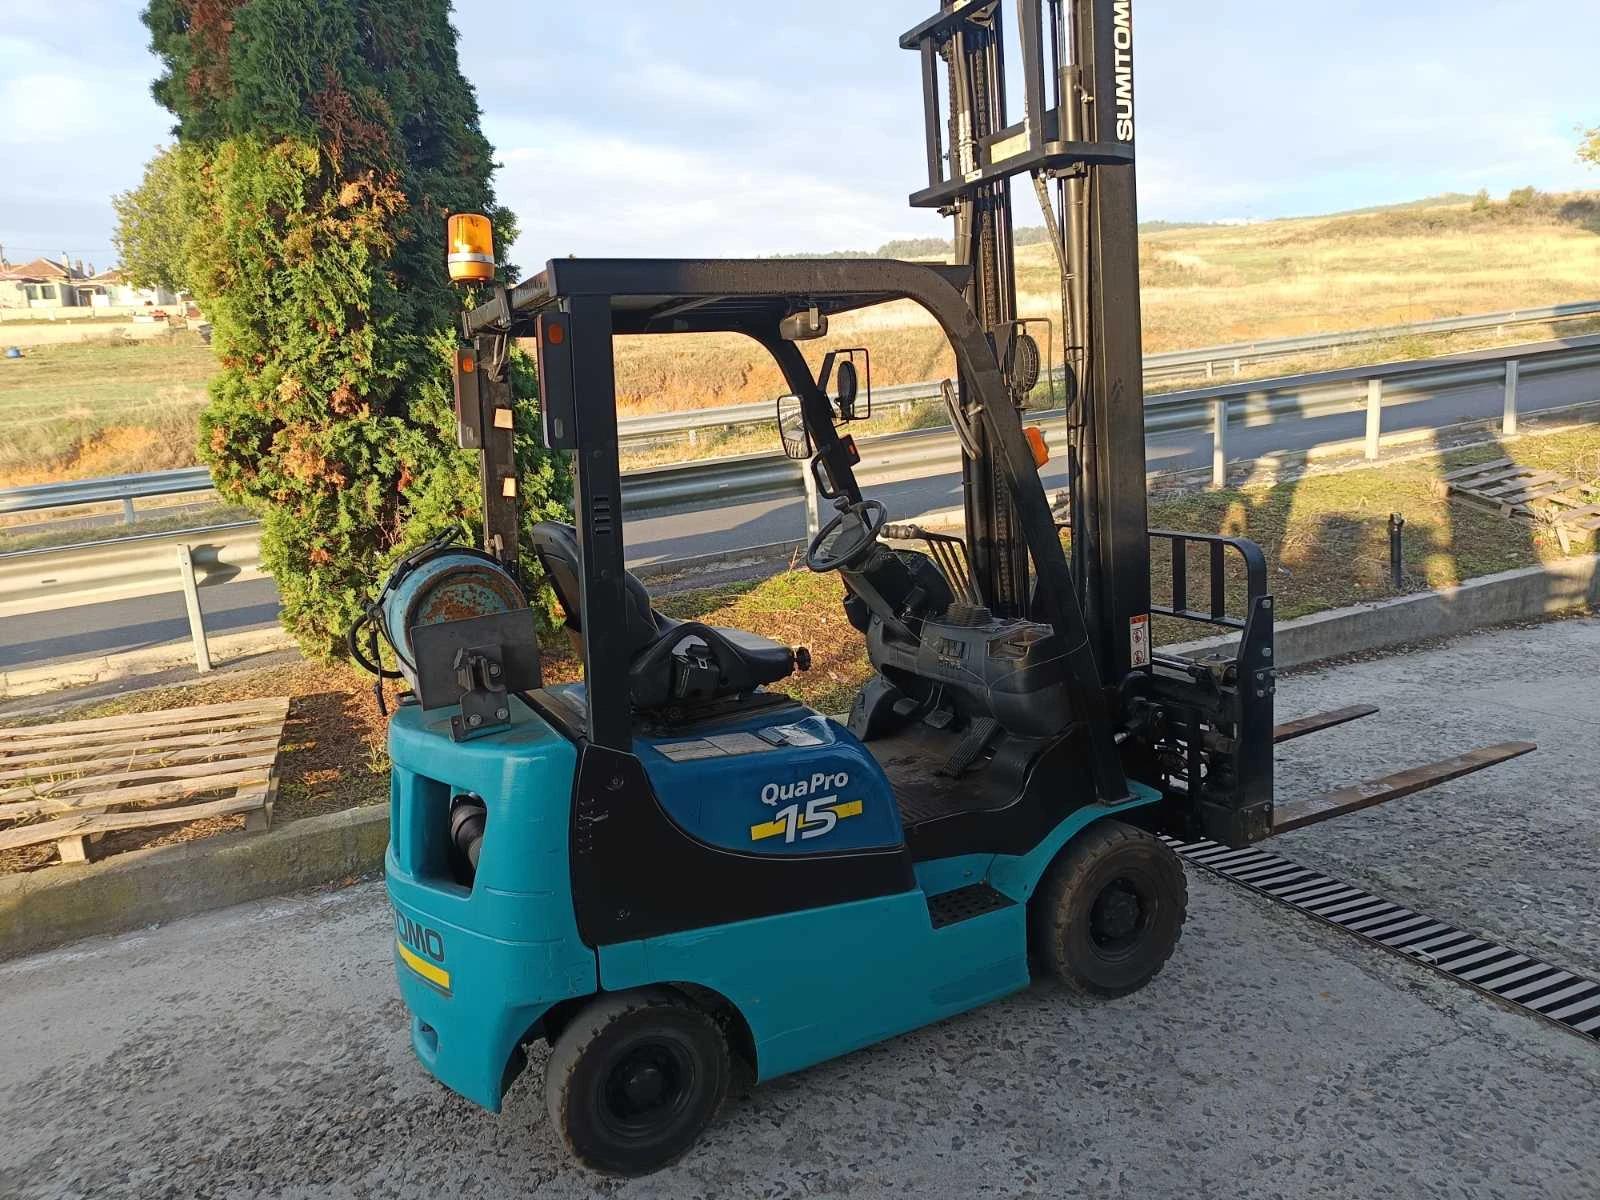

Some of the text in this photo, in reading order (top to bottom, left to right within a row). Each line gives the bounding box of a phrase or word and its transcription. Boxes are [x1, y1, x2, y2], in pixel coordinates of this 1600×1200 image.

[1114, 0, 1132, 141] SUMITOM
[761, 772, 848, 805] QuaPro
[776, 795, 838, 843] 15
